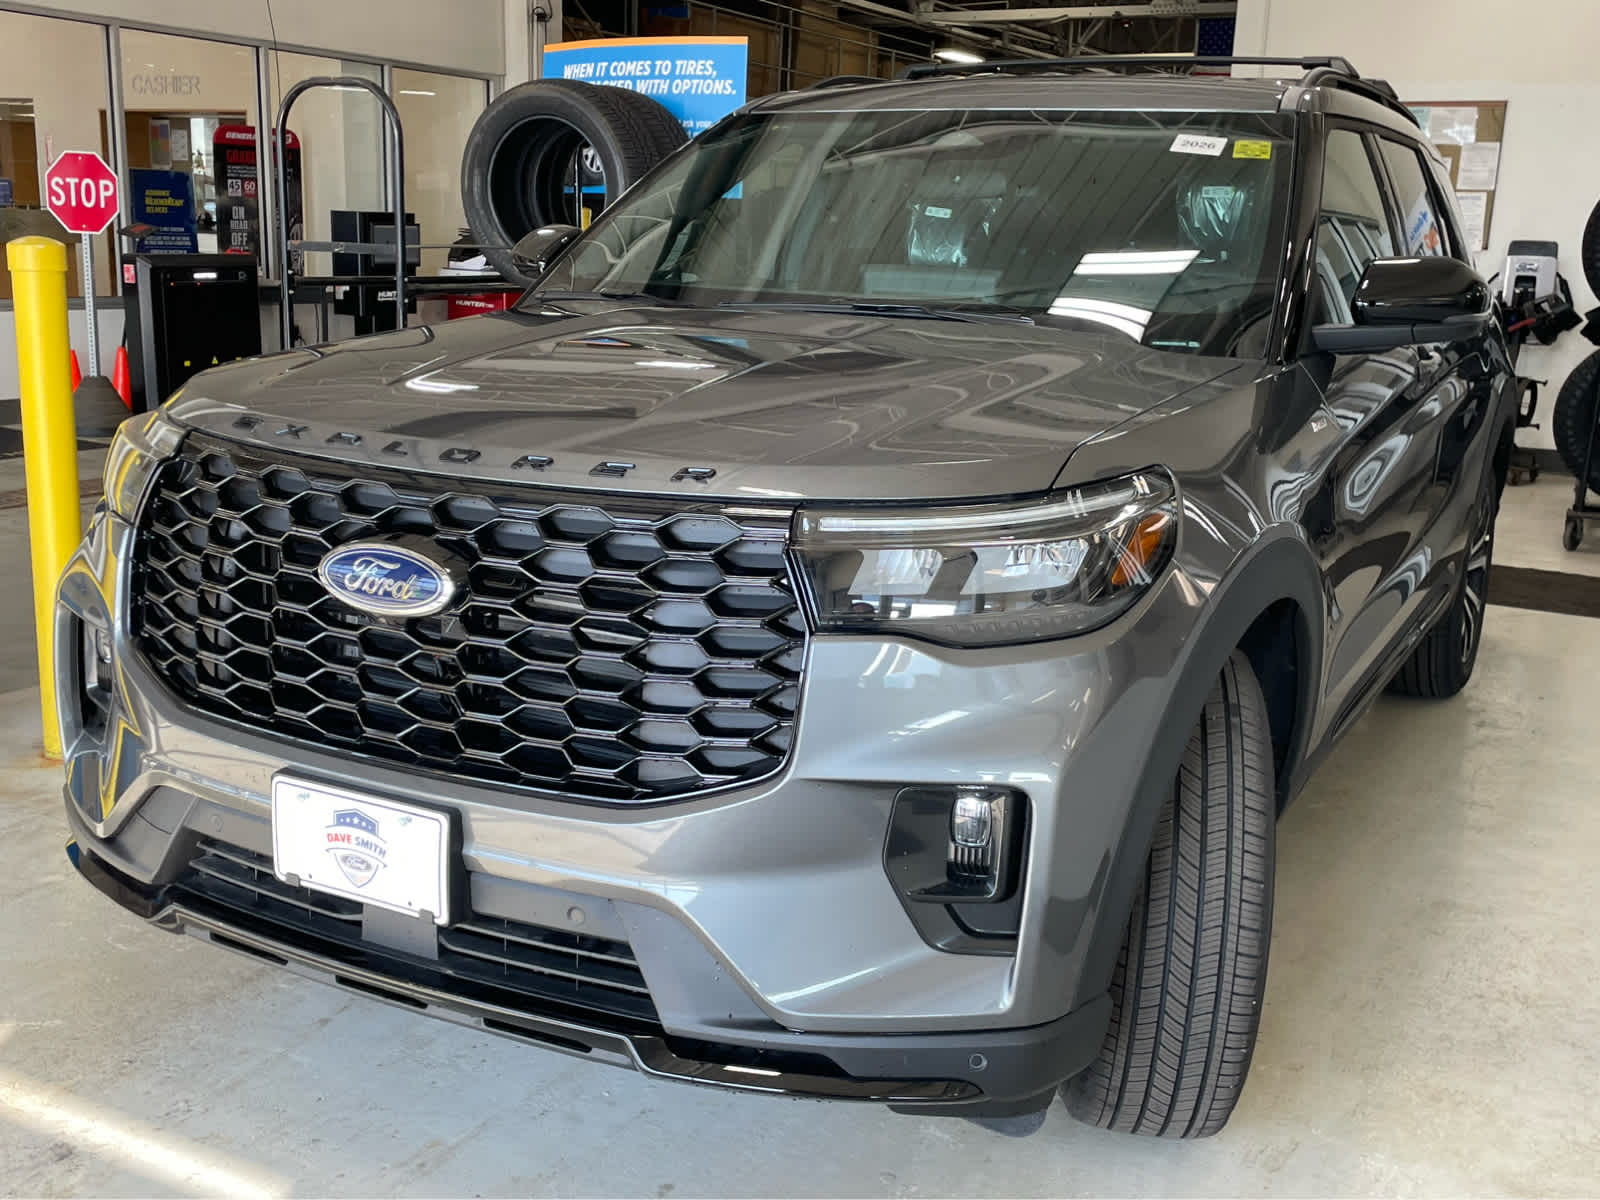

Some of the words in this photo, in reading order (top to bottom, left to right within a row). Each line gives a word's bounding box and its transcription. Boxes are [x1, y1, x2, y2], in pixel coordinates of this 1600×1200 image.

[563, 63, 595, 79] WHEN
[596, 62, 608, 77] IT
[609, 60, 651, 77] COMES
[654, 60, 672, 76] TO
[675, 60, 717, 78] TIRES,
[131, 74, 201, 96] CASHIER
[636, 79, 670, 95] WITH
[672, 79, 737, 95] OPTIONS.
[1181, 139, 1217, 150] 2026
[50, 176, 115, 209] STOP
[228, 180, 241, 192] 45
[244, 180, 256, 191] 60
[231, 232, 249, 246] OFF
[455, 300, 485, 308] HUNTER
[232, 413, 718, 484] EXPLORER
[343, 555, 416, 602] Ford
[326, 832, 352, 845] DAVE
[354, 835, 387, 859] SMITH
